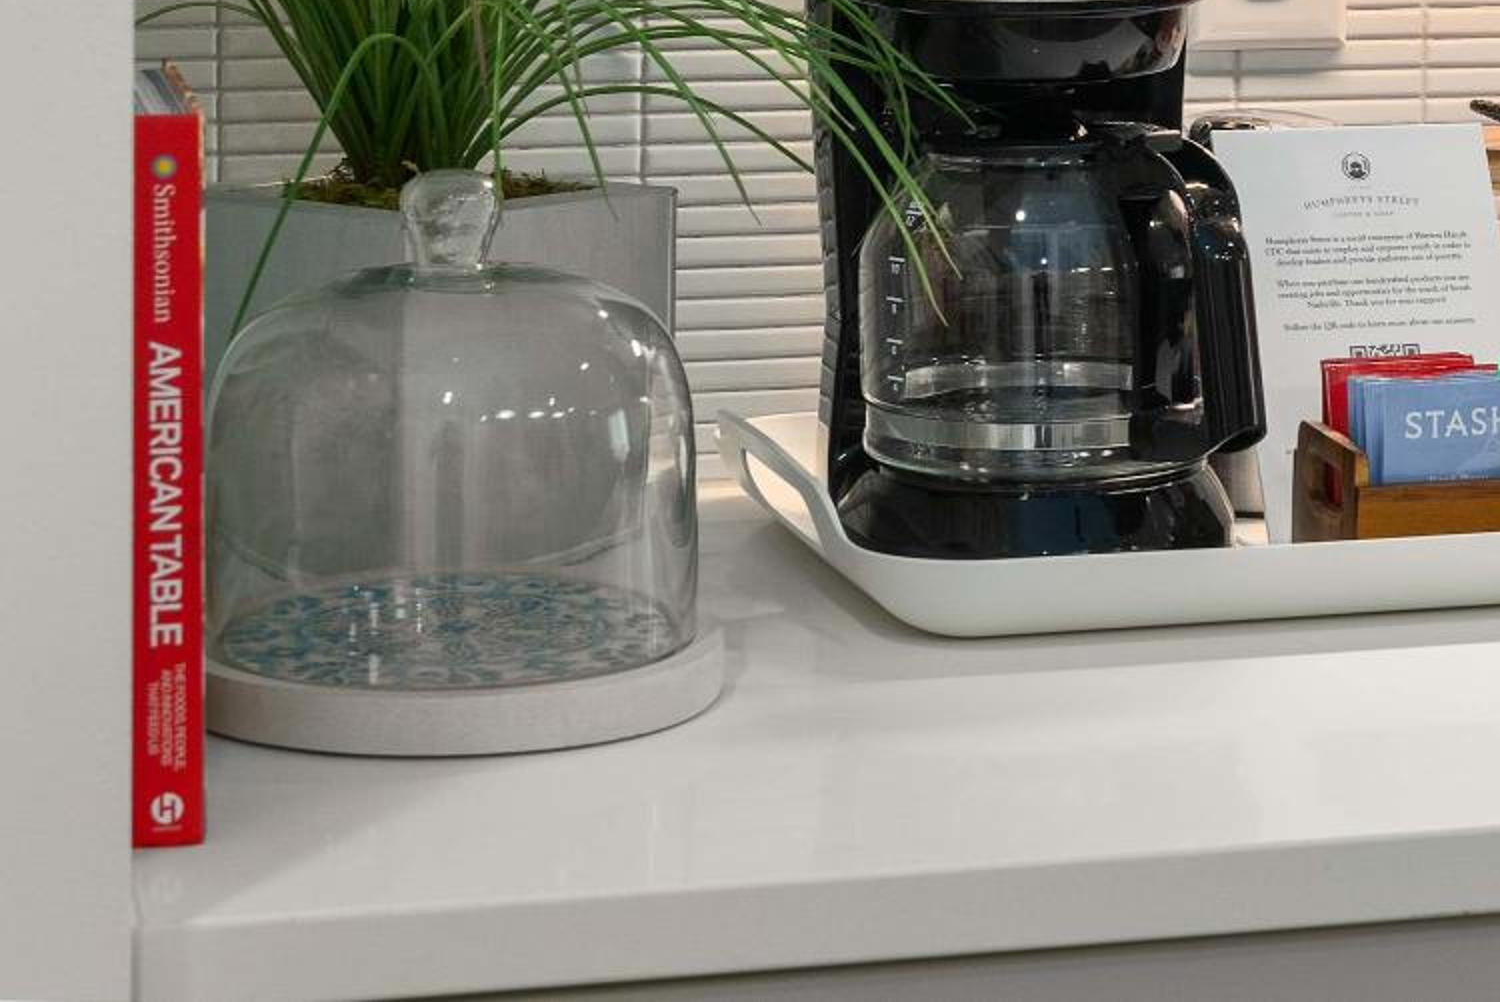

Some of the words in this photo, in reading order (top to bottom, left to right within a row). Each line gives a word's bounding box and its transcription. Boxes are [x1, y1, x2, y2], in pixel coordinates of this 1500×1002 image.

[153, 183, 177, 323] Smithsonian
[148, 341, 183, 531] AMERICAN
[148, 533, 183, 649] TABLE
